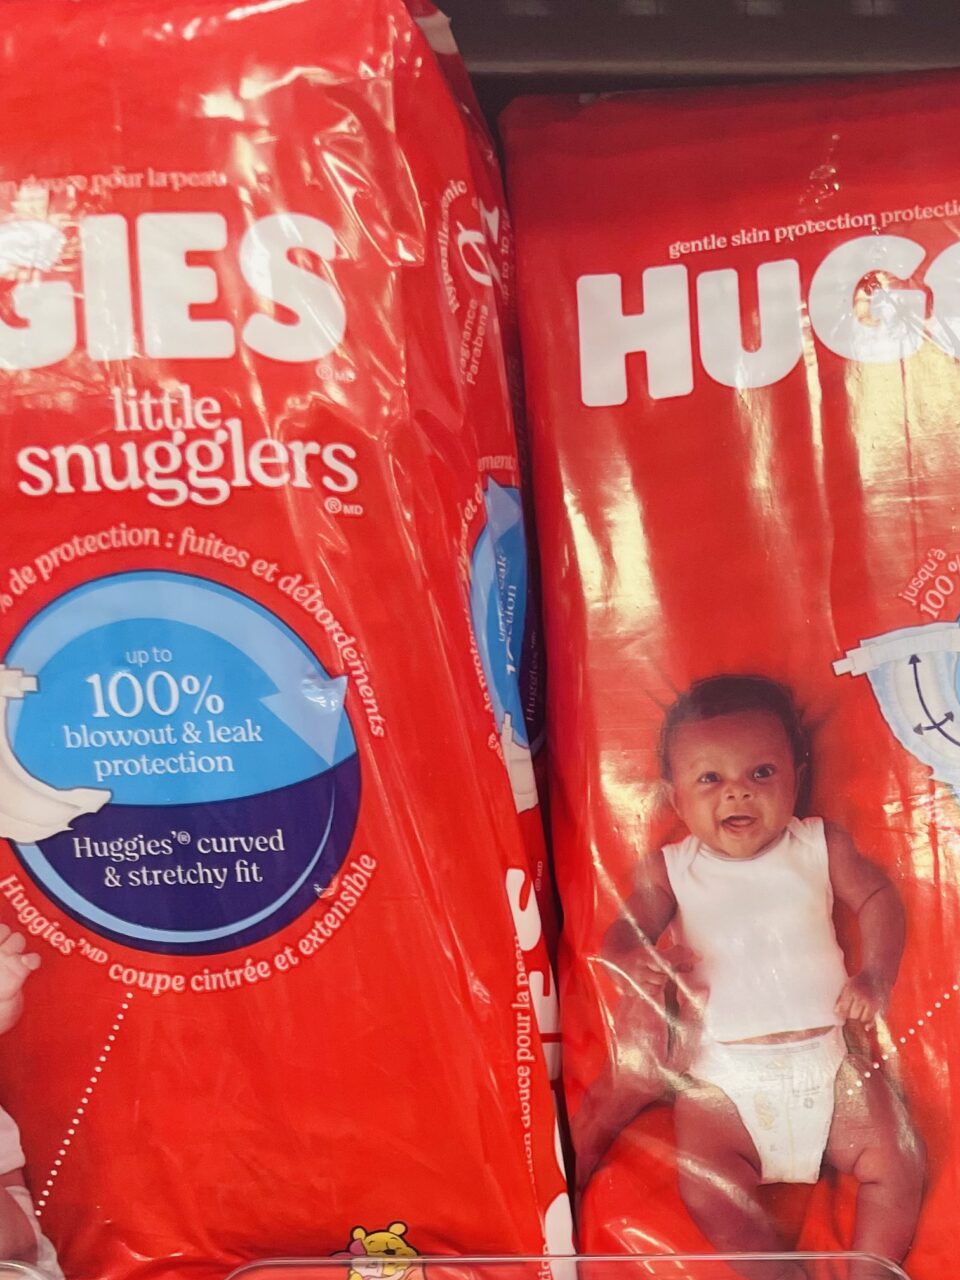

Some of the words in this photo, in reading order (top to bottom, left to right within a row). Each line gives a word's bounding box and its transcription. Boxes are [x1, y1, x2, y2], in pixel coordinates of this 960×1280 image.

[668, 234, 727, 259] gentle
[731, 229, 770, 247] skin
[774, 212, 876, 243] protection
[113, 385, 221, 431] little
[17, 420, 358, 507] snugglers
[920, 575, 954, 619] 100
[9, 567, 37, 594] de
[35, 524, 160, 580] protection
[178, 525, 250, 568] fuites
[252, 555, 278, 577] et
[278, 572, 385, 739] débordements
[126, 647, 149, 666] up
[152, 646, 172, 663] to
[86, 670, 224, 718] 100%
[63, 722, 177, 750] blowout
[182, 720, 204, 743] &
[208, 719, 263, 743] leak
[94, 750, 235, 782] protection
[197, 829, 285, 854] curved
[104, 867, 122, 888] &
[128, 861, 228, 889] stretchy
[235, 859, 263, 884] fit
[108, 961, 185, 993] coupe
[190, 957, 271, 992] cintrée
[274, 945, 299, 970] et
[298, 851, 377, 955] extensible
[512, 989, 530, 1008] la
[517, 1013, 535, 1062] pour
[517, 1065, 531, 1129] douce
